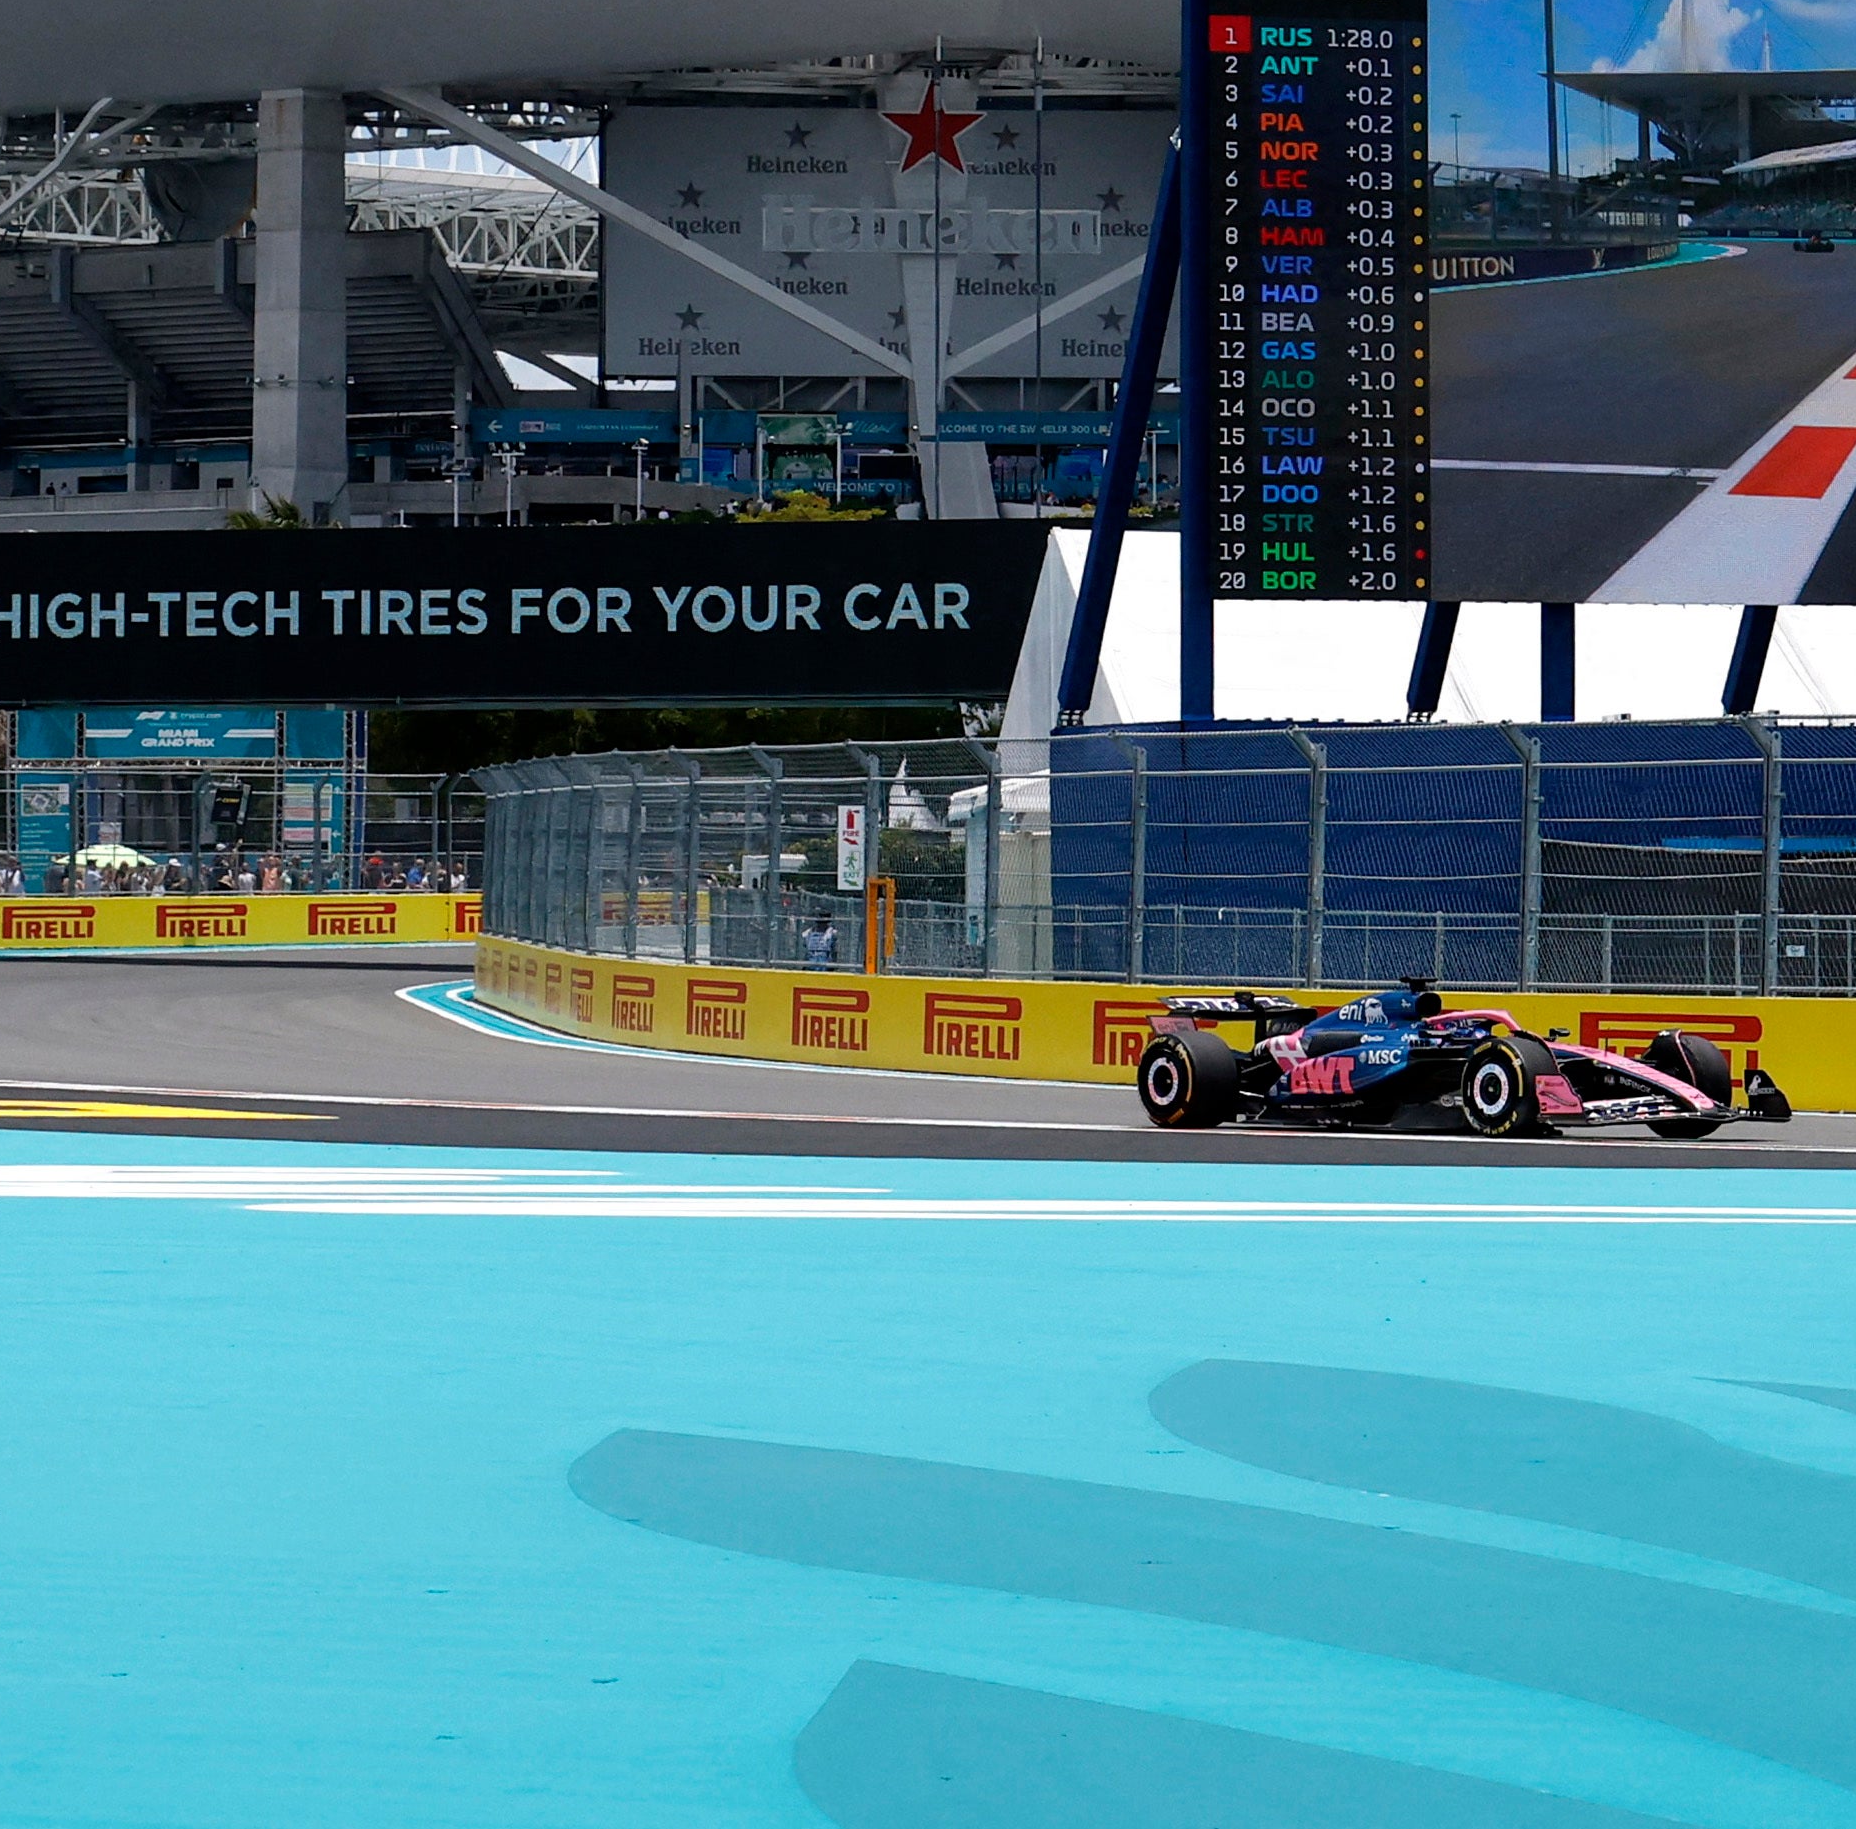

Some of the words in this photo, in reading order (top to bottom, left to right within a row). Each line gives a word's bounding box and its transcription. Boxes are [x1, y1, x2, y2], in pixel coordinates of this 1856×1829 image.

[1225, 28, 1237, 44] 1
[1261, 27, 1313, 46] RUS
[1328, 29, 1392, 48] 1:28.0
[1225, 56, 1237, 73] 2
[1261, 56, 1318, 75] ANT
[1346, 58, 1392, 77] +0.1
[1226, 85, 1237, 101] 3
[1262, 84, 1304, 103] SAI
[1346, 87, 1392, 105] +0.2
[1226, 114, 1237, 129] 4
[1261, 113, 1303, 131] PIA
[1347, 115, 1392, 133] +0.2
[1226, 142, 1237, 158] 5
[1261, 142, 1318, 160] NOR
[1347, 144, 1392, 162] +0.3
[747, 155, 848, 173] Heineken
[966, 158, 1056, 176] eineken
[1226, 171, 1237, 186] 6
[1261, 170, 1307, 188] LEC
[1347, 172, 1392, 190] +0.3
[1226, 199, 1237, 215] 7
[1262, 199, 1313, 217] ALB
[1347, 201, 1392, 218] +0.3
[762, 193, 1099, 252] Heineken
[1226, 227, 1238, 244] 8
[1261, 228, 1323, 245] HAM
[1347, 229, 1394, 247] +0.4
[1226, 256, 1237, 272] 9
[1262, 256, 1313, 275] VER
[1347, 257, 1393, 275] +0.5
[956, 277, 1056, 296] Heineken
[1220, 284, 1244, 301] 10
[1262, 284, 1320, 303] HAD
[1347, 286, 1394, 304] +0.6
[1220, 313, 1244, 330] 11
[1262, 312, 1314, 332] BEA
[1348, 314, 1394, 332] +0.9
[1061, 338, 1127, 358] Heine
[1220, 342, 1244, 358] 12
[1262, 341, 1316, 360] GAS
[1348, 343, 1394, 361] +1.0
[1220, 370, 1244, 387] 13
[1263, 371, 1313, 388] ALO
[1348, 371, 1395, 390] +1.0
[1220, 399, 1244, 416] 14
[1262, 398, 1315, 417] OCO
[1348, 400, 1394, 418] +1.1
[981, 424, 995, 434] TO
[1220, 428, 1244, 445] 15
[1262, 427, 1314, 446] TSU
[1348, 429, 1394, 447] +1.1
[1220, 456, 1244, 473] 16
[1262, 456, 1324, 475] LAW
[1349, 457, 1394, 476] +1.2
[813, 481, 876, 492] WELCOME
[879, 481, 896, 492] TO
[1220, 485, 1244, 502] 17
[1263, 485, 1319, 503] DOO
[1349, 486, 1395, 504] +1.2
[1220, 514, 1245, 531] 18
[1264, 515, 1313, 531] STR
[1349, 515, 1395, 532] +1.6
[1220, 543, 1245, 560] 19
[1263, 542, 1314, 561] HUL
[1349, 543, 1395, 561] +1.6
[1220, 572, 1245, 589] 20
[1263, 571, 1316, 589] BOR
[1349, 572, 1396, 590] +2.0
[321, 587, 488, 636] TIRES
[510, 586, 633, 634] FOR
[652, 584, 821, 633] YOUR
[843, 582, 971, 631] CAR
[141, 737, 185, 747] GRAND
[186, 737, 215, 747] PRIX
[158, 728, 199, 738] MIAMI
[2, 906, 95, 939] PIRELLI
[157, 904, 247, 937] PIRELLI
[309, 903, 397, 935] PIRELLI
[613, 975, 655, 1033] PIRELLI
[687, 979, 747, 1040] PIRELLI
[1339, 999, 1365, 1021] eni
[793, 987, 869, 1052] PIRELLI
[924, 993, 1022, 1061] PIRELLI
[1368, 1049, 1402, 1065] MSC
